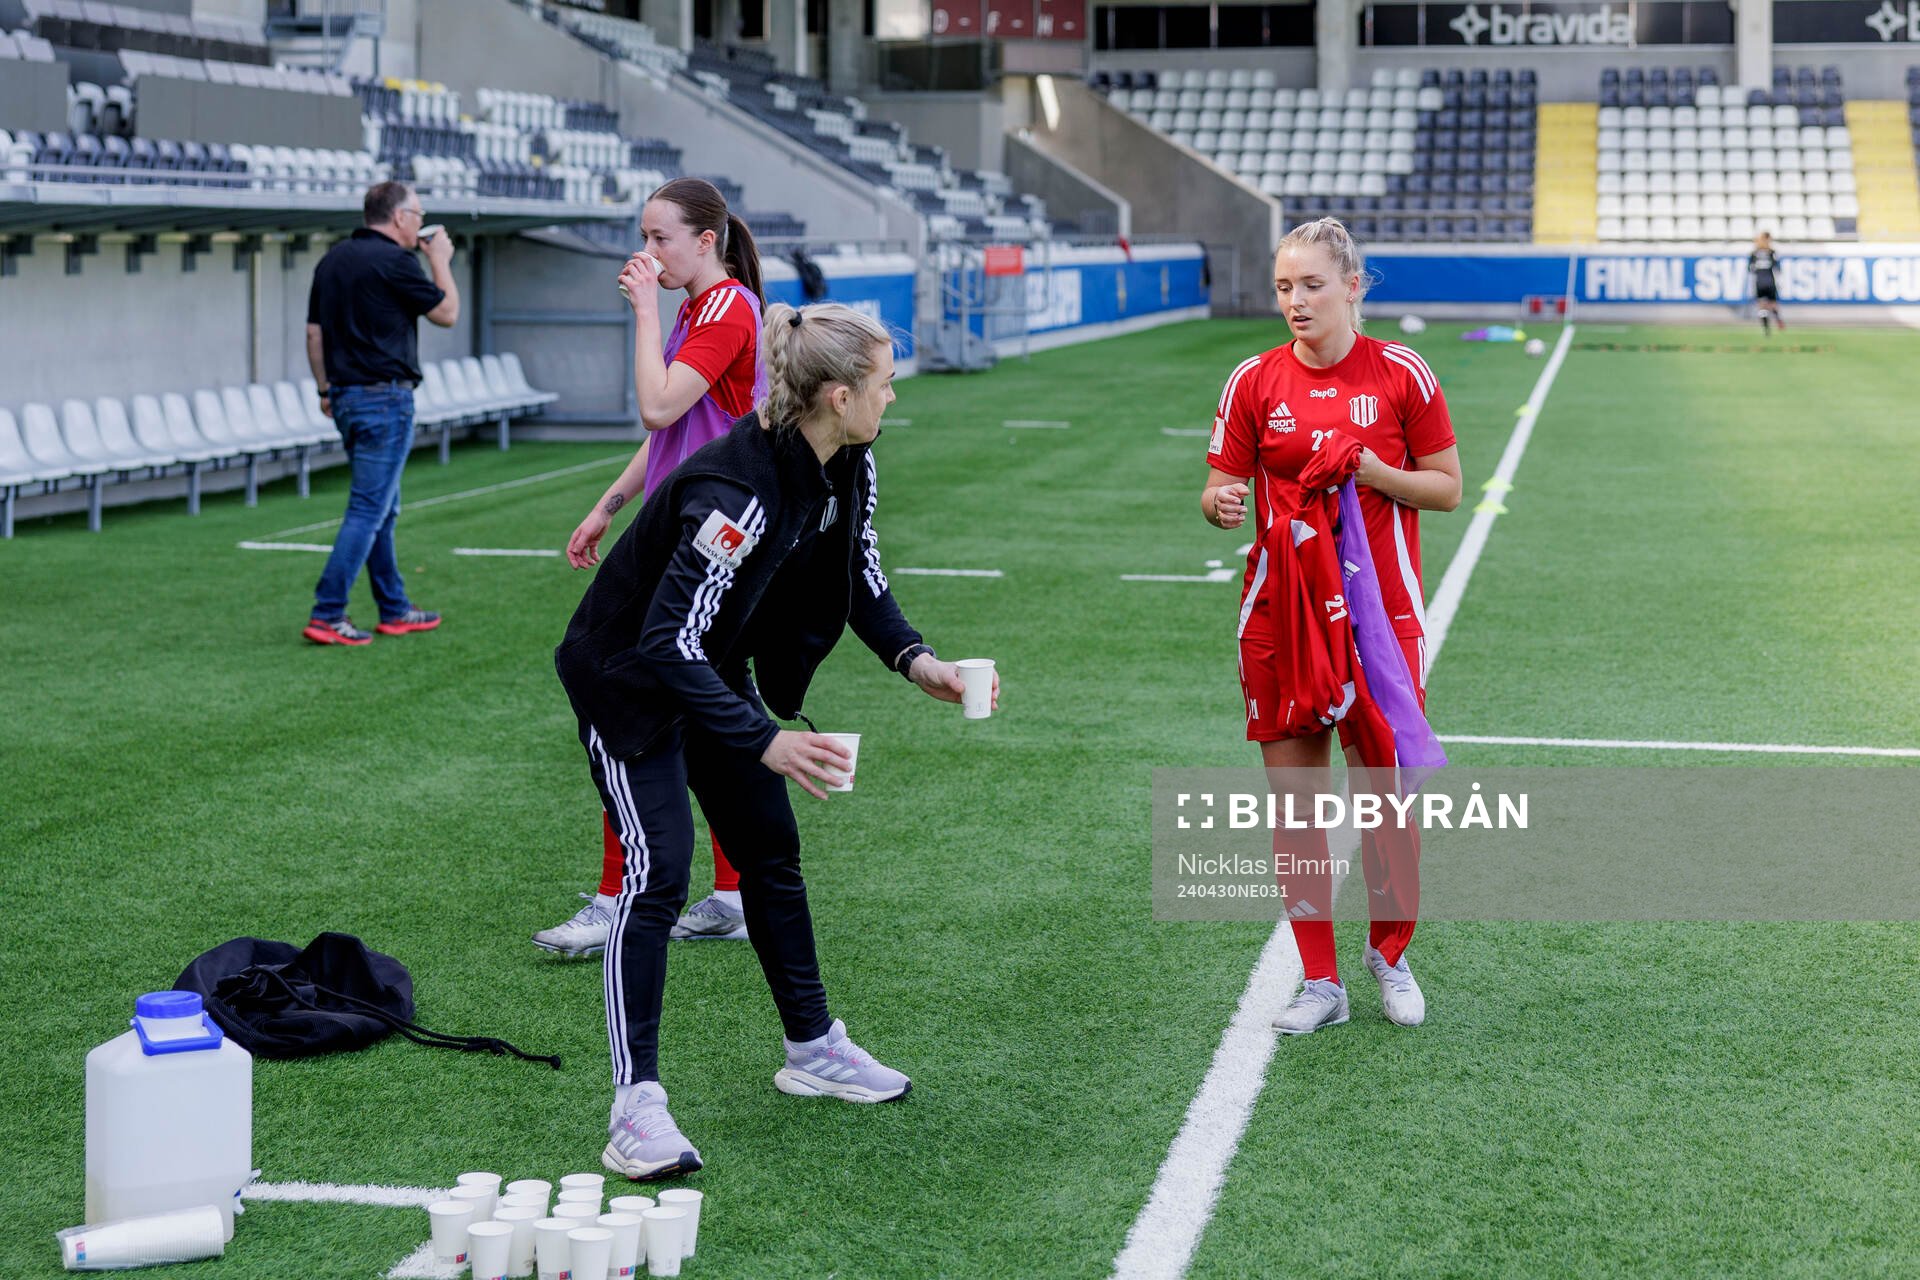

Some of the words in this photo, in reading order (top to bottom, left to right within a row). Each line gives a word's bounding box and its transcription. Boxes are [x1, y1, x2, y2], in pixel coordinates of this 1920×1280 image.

[1490, 4, 1635, 44] bravida
[1585, 257, 1692, 301] FINAL
[1694, 257, 1869, 301] SVNSKA
[1268, 417, 1296, 430] sport
[696, 538, 723, 562] SVENSKA
[1325, 594, 1348, 622] 21
